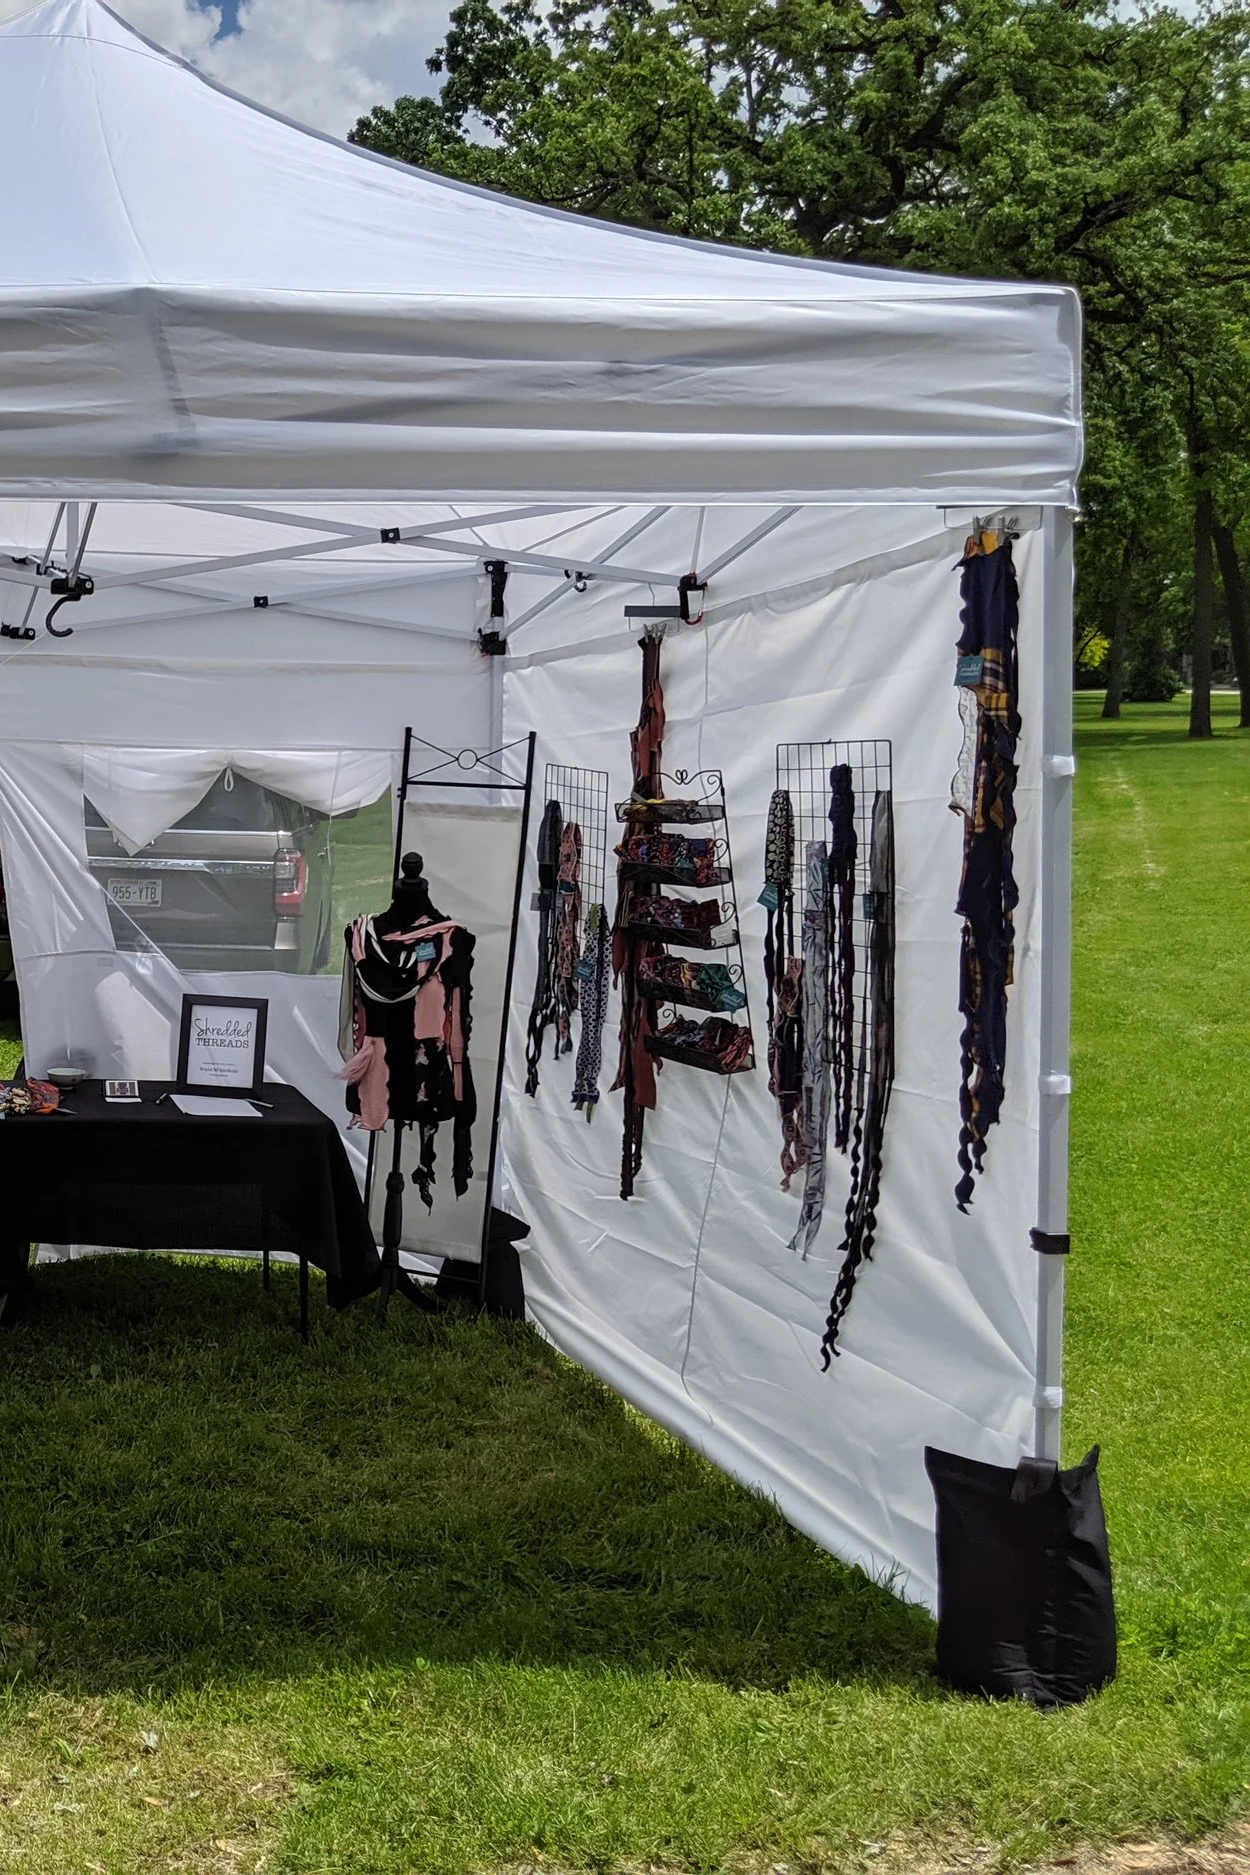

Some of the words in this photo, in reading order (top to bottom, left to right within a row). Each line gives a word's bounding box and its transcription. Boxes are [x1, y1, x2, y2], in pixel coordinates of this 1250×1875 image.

[112, 885, 157, 900] 955-YTB
[194, 1017, 253, 1038] Shredded
[195, 1037, 250, 1049] THREADS
